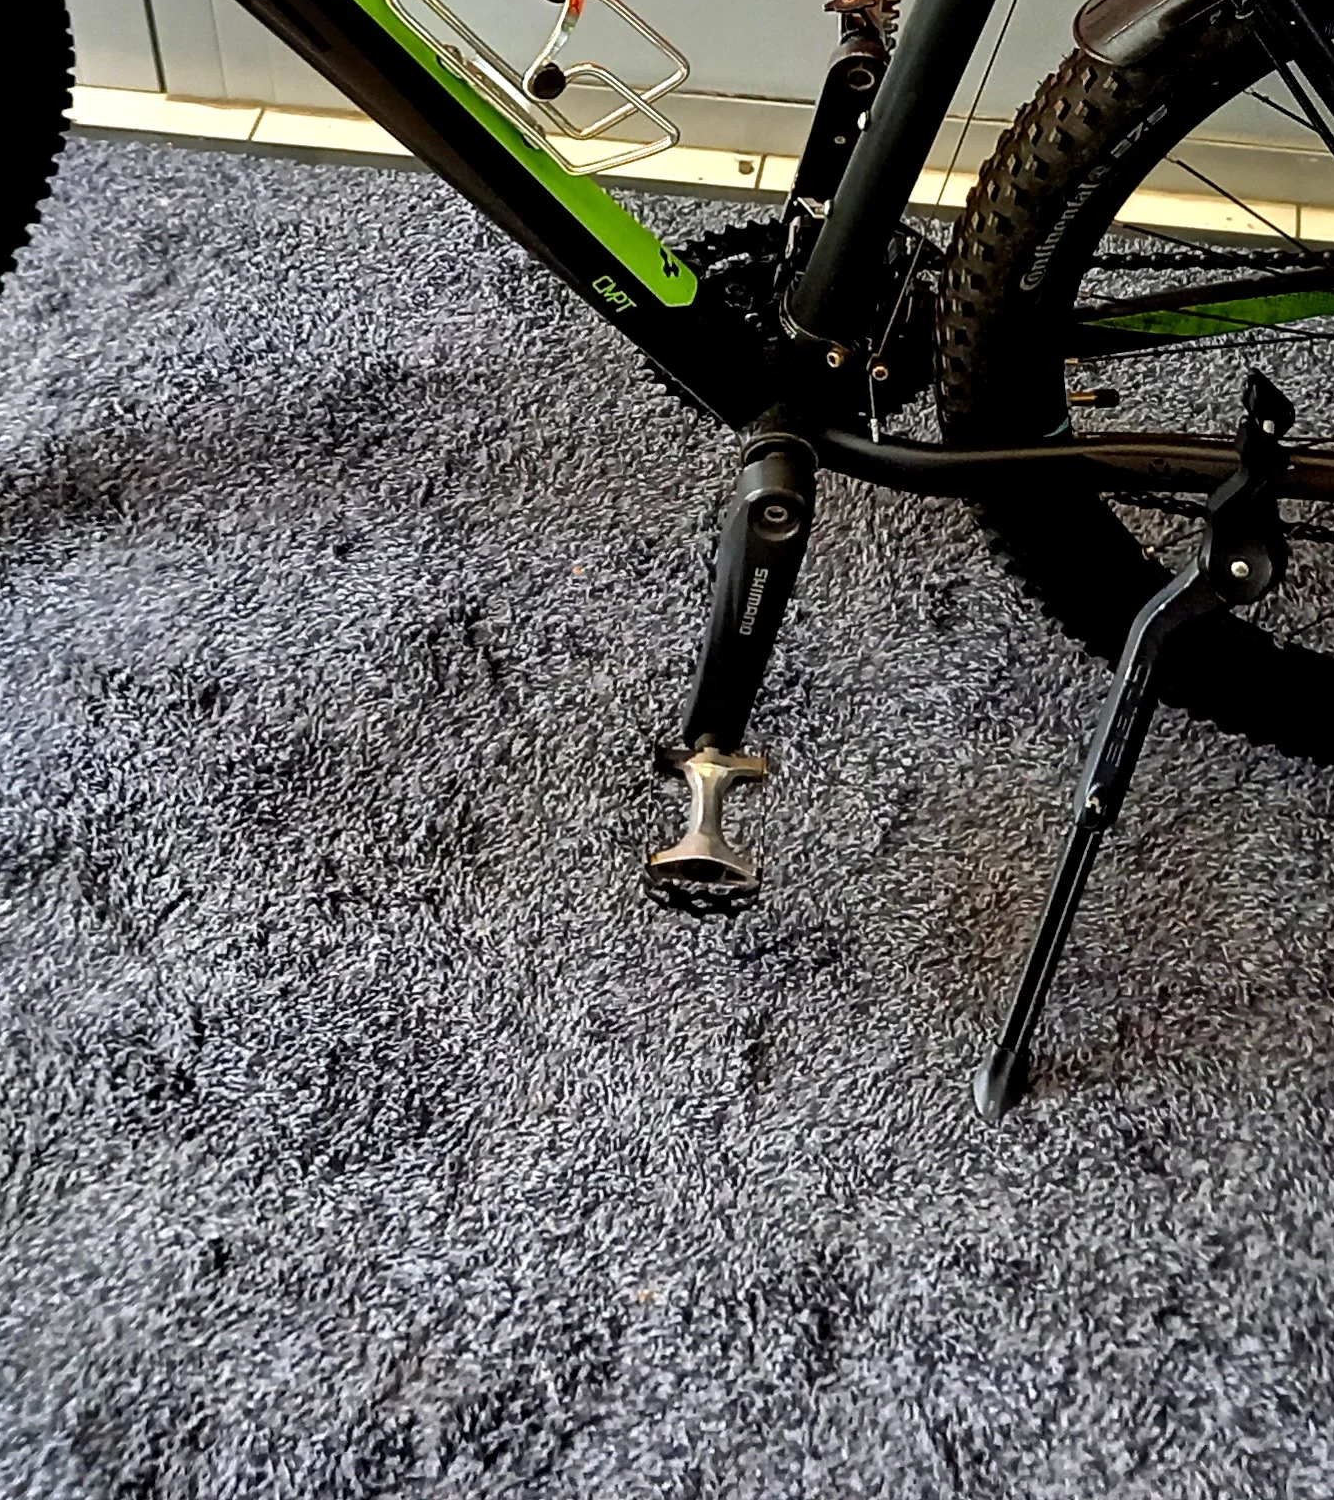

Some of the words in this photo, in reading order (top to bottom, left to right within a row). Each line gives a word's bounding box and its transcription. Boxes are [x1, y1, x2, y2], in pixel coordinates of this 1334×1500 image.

[1019, 182, 1102, 291] Continental
[592, 275, 638, 313] CMPT
[739, 567, 769, 636] SHIMANO
